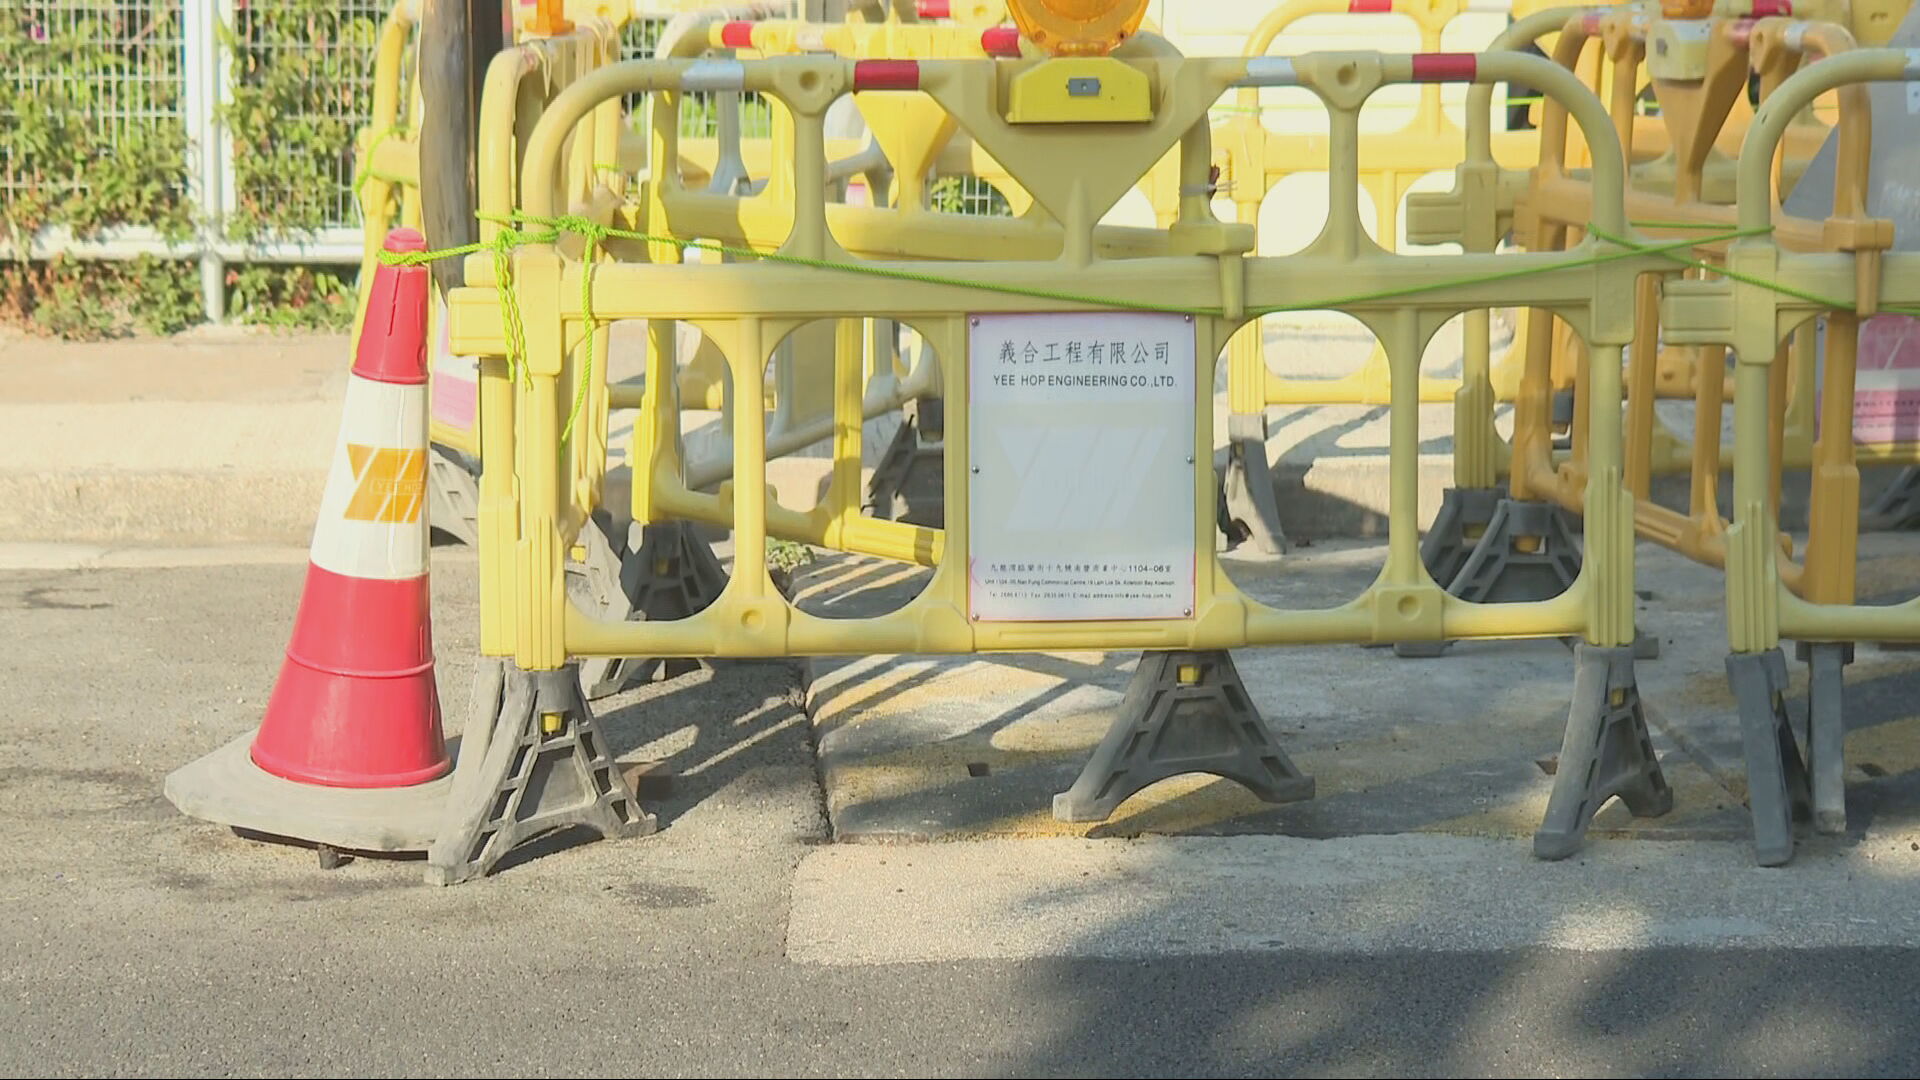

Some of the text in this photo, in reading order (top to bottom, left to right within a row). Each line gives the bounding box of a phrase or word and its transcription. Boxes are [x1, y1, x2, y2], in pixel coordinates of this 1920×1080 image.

[1000, 340, 1169, 365] 義合工程有限公司
[993, 375, 1015, 386] YEE
[1021, 375, 1045, 386] HOP
[1048, 375, 1128, 386] ENGINEERING
